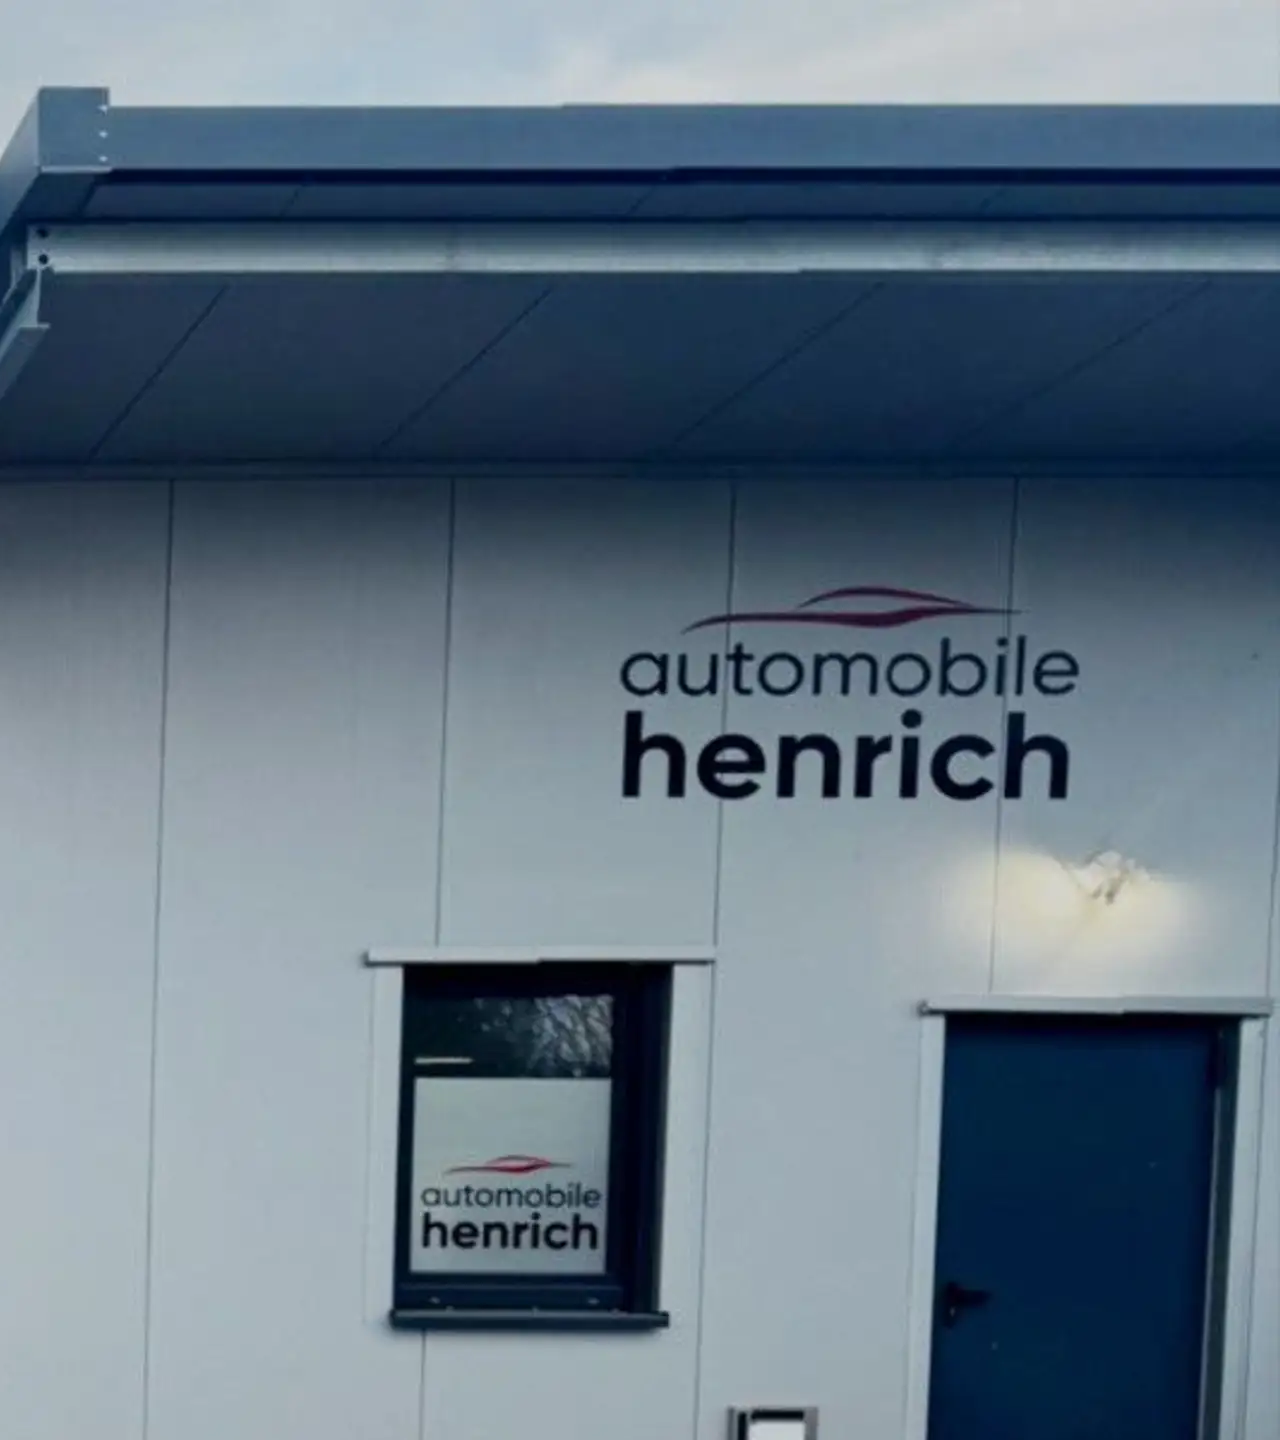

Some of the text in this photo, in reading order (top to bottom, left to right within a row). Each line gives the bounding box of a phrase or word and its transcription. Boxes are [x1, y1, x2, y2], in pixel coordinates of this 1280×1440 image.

[620, 634, 1080, 697] automobile
[621, 709, 1070, 801] henrich
[421, 1183, 602, 1208] automobile
[422, 1211, 599, 1250] henrich
